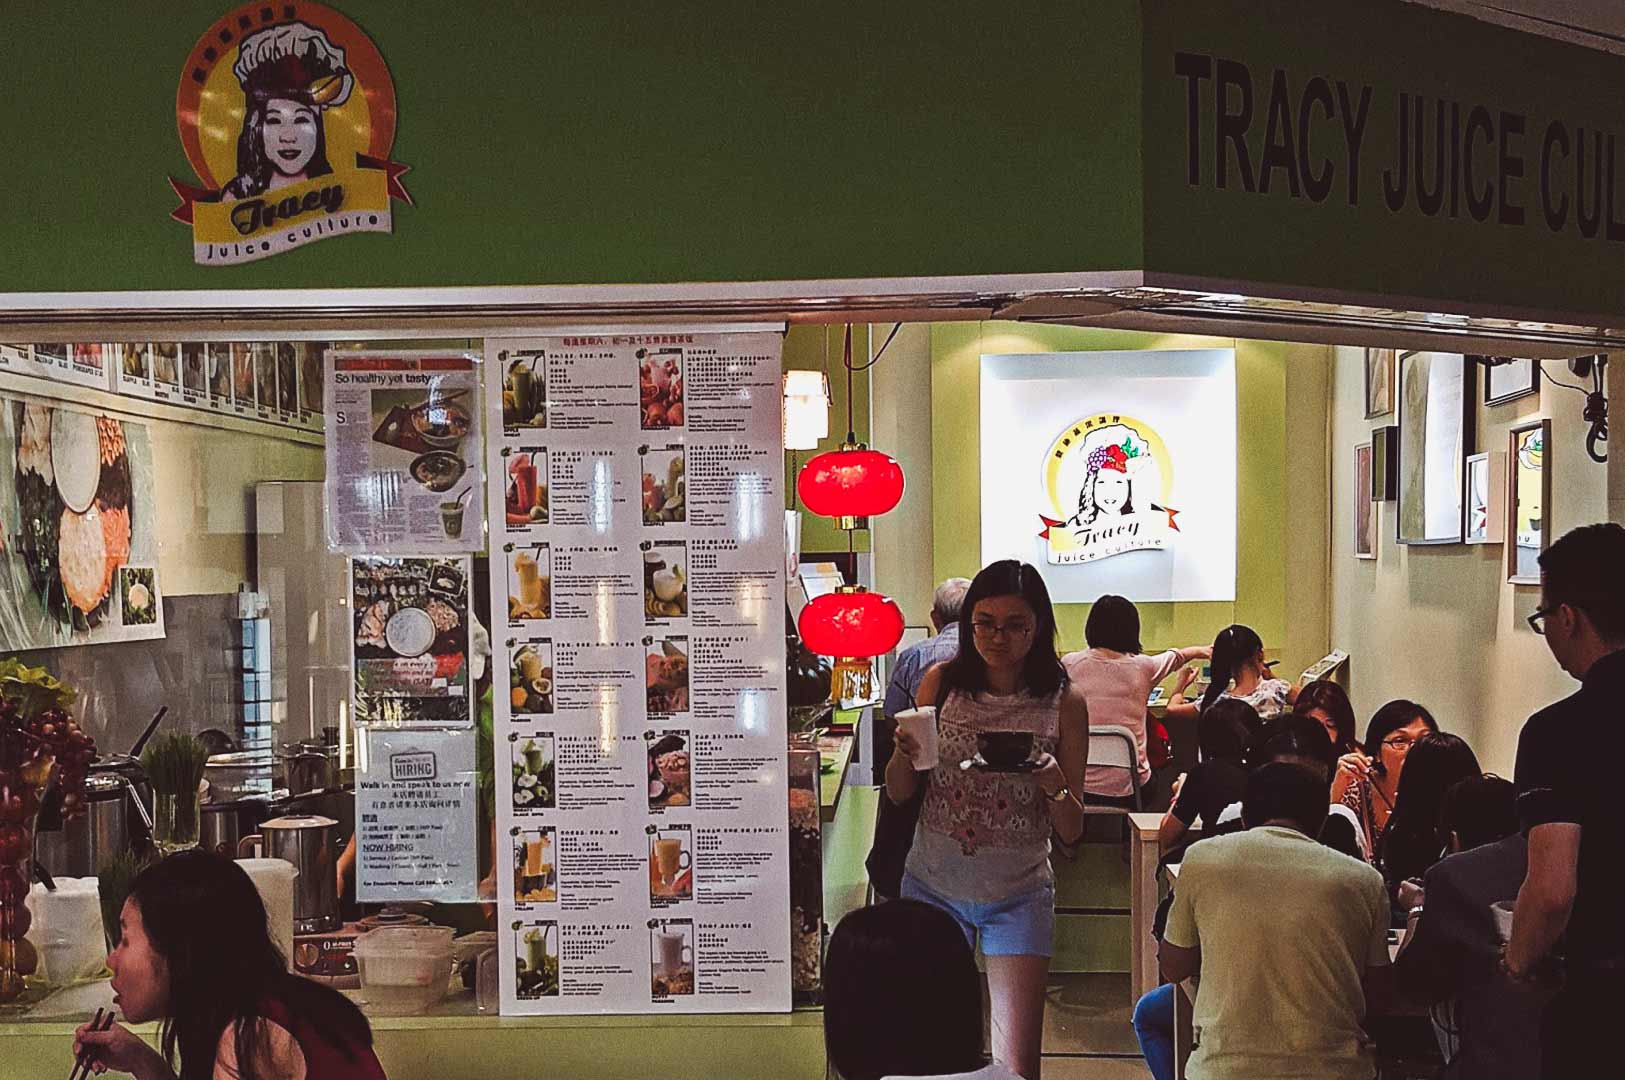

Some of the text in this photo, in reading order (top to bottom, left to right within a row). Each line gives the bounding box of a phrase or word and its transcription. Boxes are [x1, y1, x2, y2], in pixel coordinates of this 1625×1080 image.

[1174, 51, 1373, 207] TRACY
[1382, 92, 1526, 226] JUICE
[231, 184, 345, 236] Tracy
[287, 214, 378, 243] culture
[335, 373, 432, 386] So healthy yet tasty
[336, 411, 346, 424] S
[1074, 522, 1140, 546] Tracy
[395, 762, 432, 777] HIRING
[360, 781, 380, 789] Walk
[391, 781, 406, 789] and
[408, 781, 431, 791] speak
[363, 843, 414, 852] NOW HIRING
